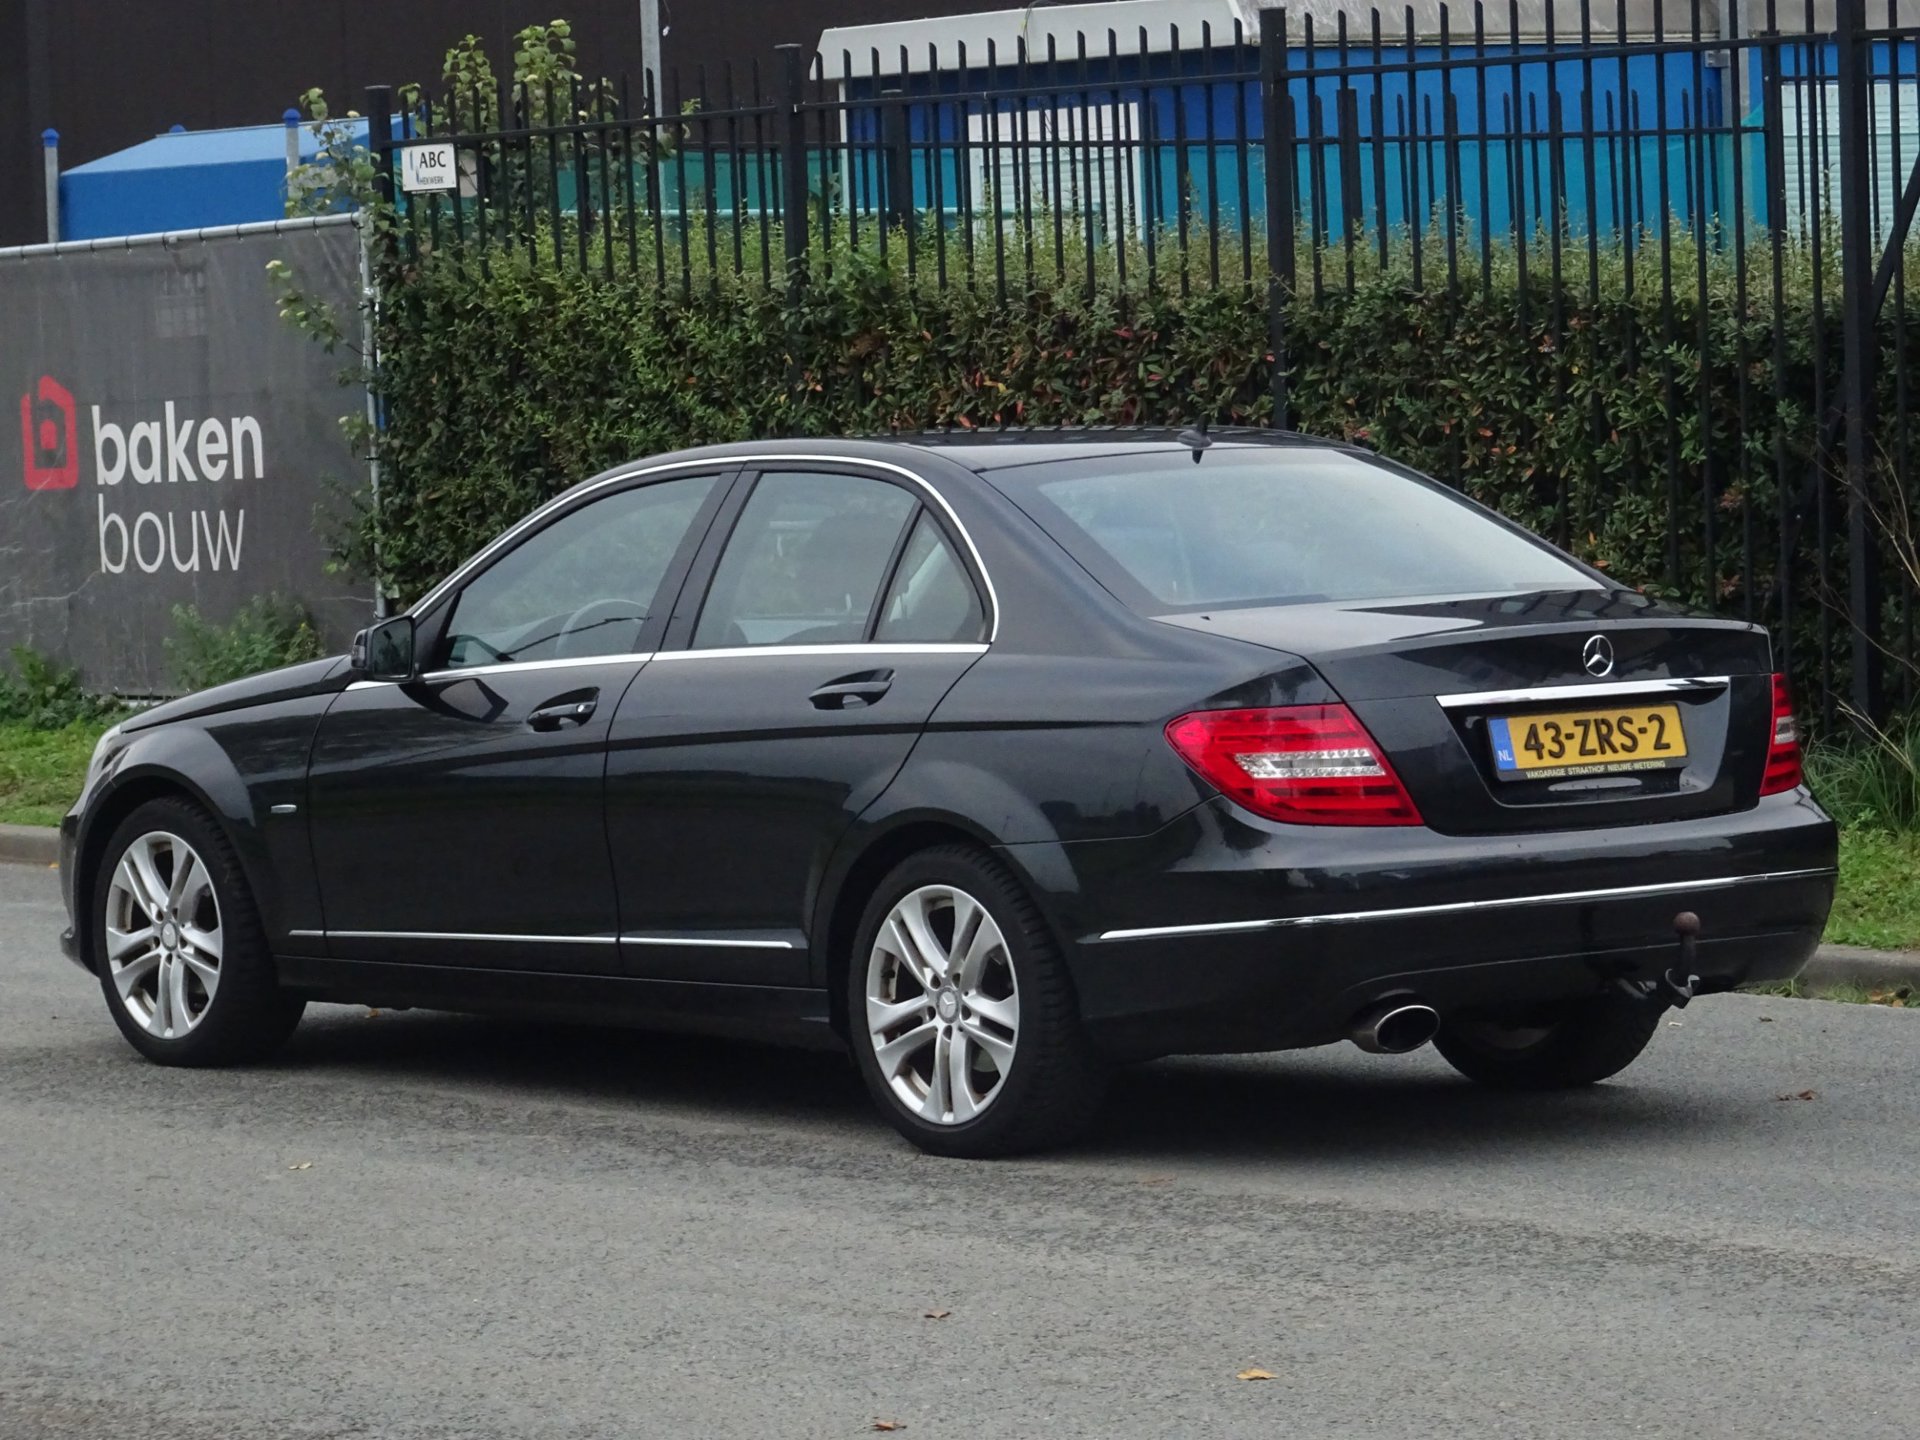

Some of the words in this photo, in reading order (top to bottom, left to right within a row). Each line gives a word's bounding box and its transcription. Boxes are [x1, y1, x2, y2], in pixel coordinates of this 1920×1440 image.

[419, 150, 446, 168] ABC
[92, 400, 264, 485] baken
[98, 493, 244, 574] bouw
[1524, 713, 1671, 760] 43-ZRS-2
[1498, 750, 1512, 761] NL
[1526, 767, 1566, 779] VAKGARAGE
[1567, 764, 1605, 776] STRAATHOF
